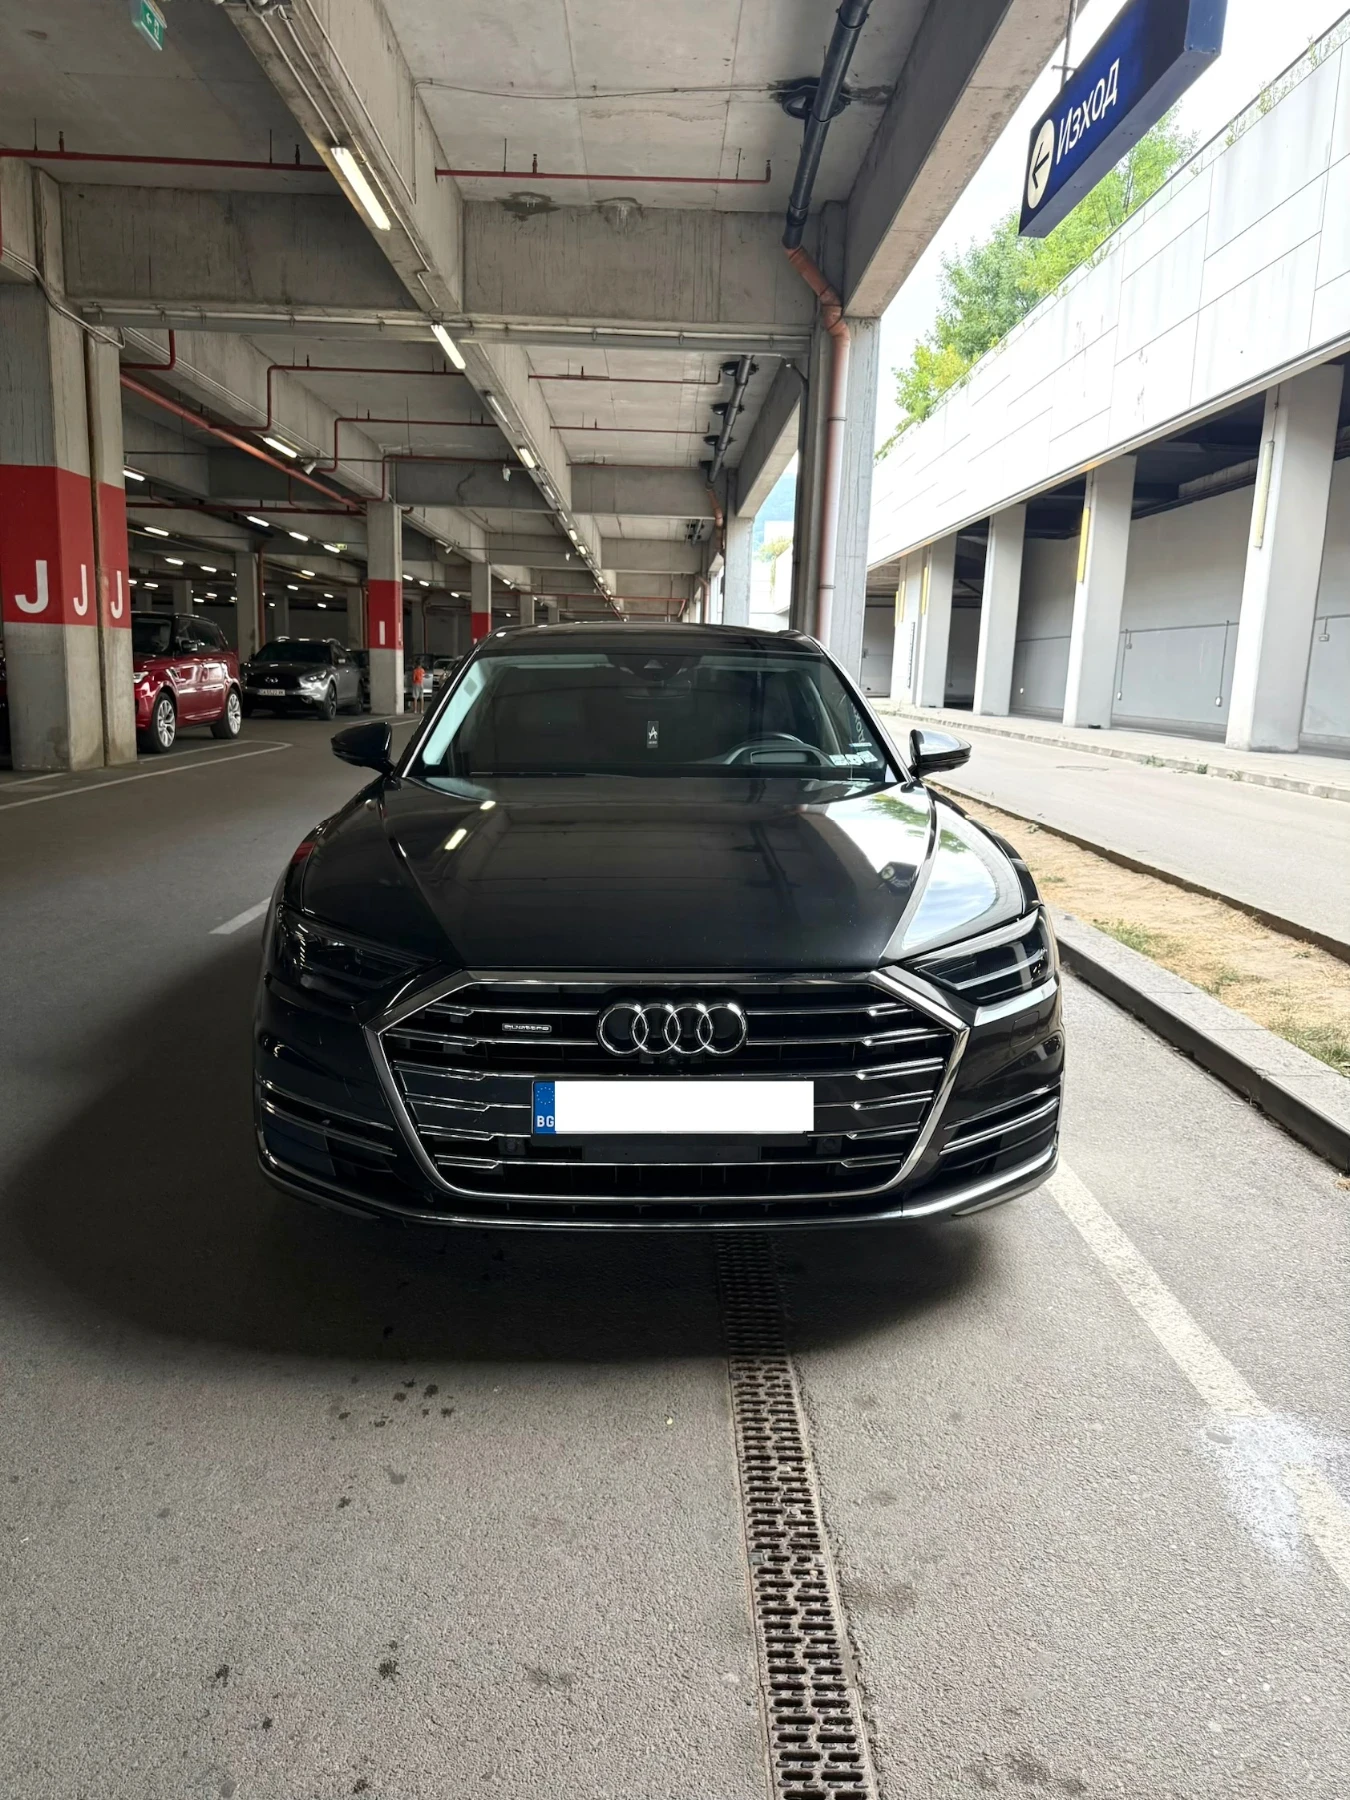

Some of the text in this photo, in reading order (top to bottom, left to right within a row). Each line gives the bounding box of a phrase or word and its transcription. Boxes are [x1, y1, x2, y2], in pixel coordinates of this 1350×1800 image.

[1056, 57, 1120, 164] ИЗХОД
[15, 559, 49, 614] J
[73, 563, 88, 616] J
[110, 570, 123, 619] J
[536, 1115, 555, 1128] BG
